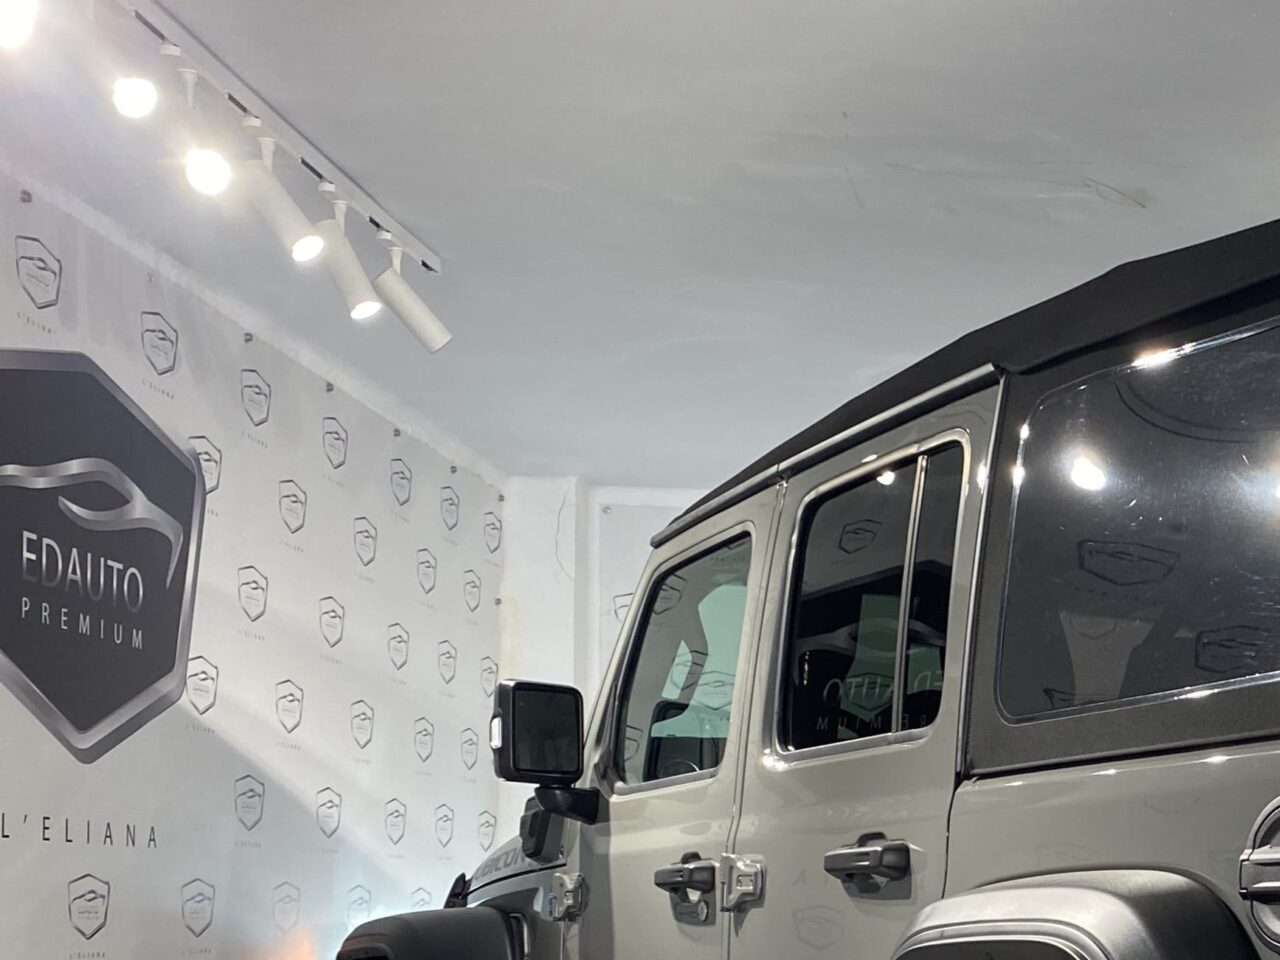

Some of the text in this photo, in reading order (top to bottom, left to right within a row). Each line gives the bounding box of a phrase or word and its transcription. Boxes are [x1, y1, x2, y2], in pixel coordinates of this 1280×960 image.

[22, 530, 143, 613] EDAUTO
[21, 596, 143, 650] PREMIUM
[1, 812, 157, 849] L'ELIANA
